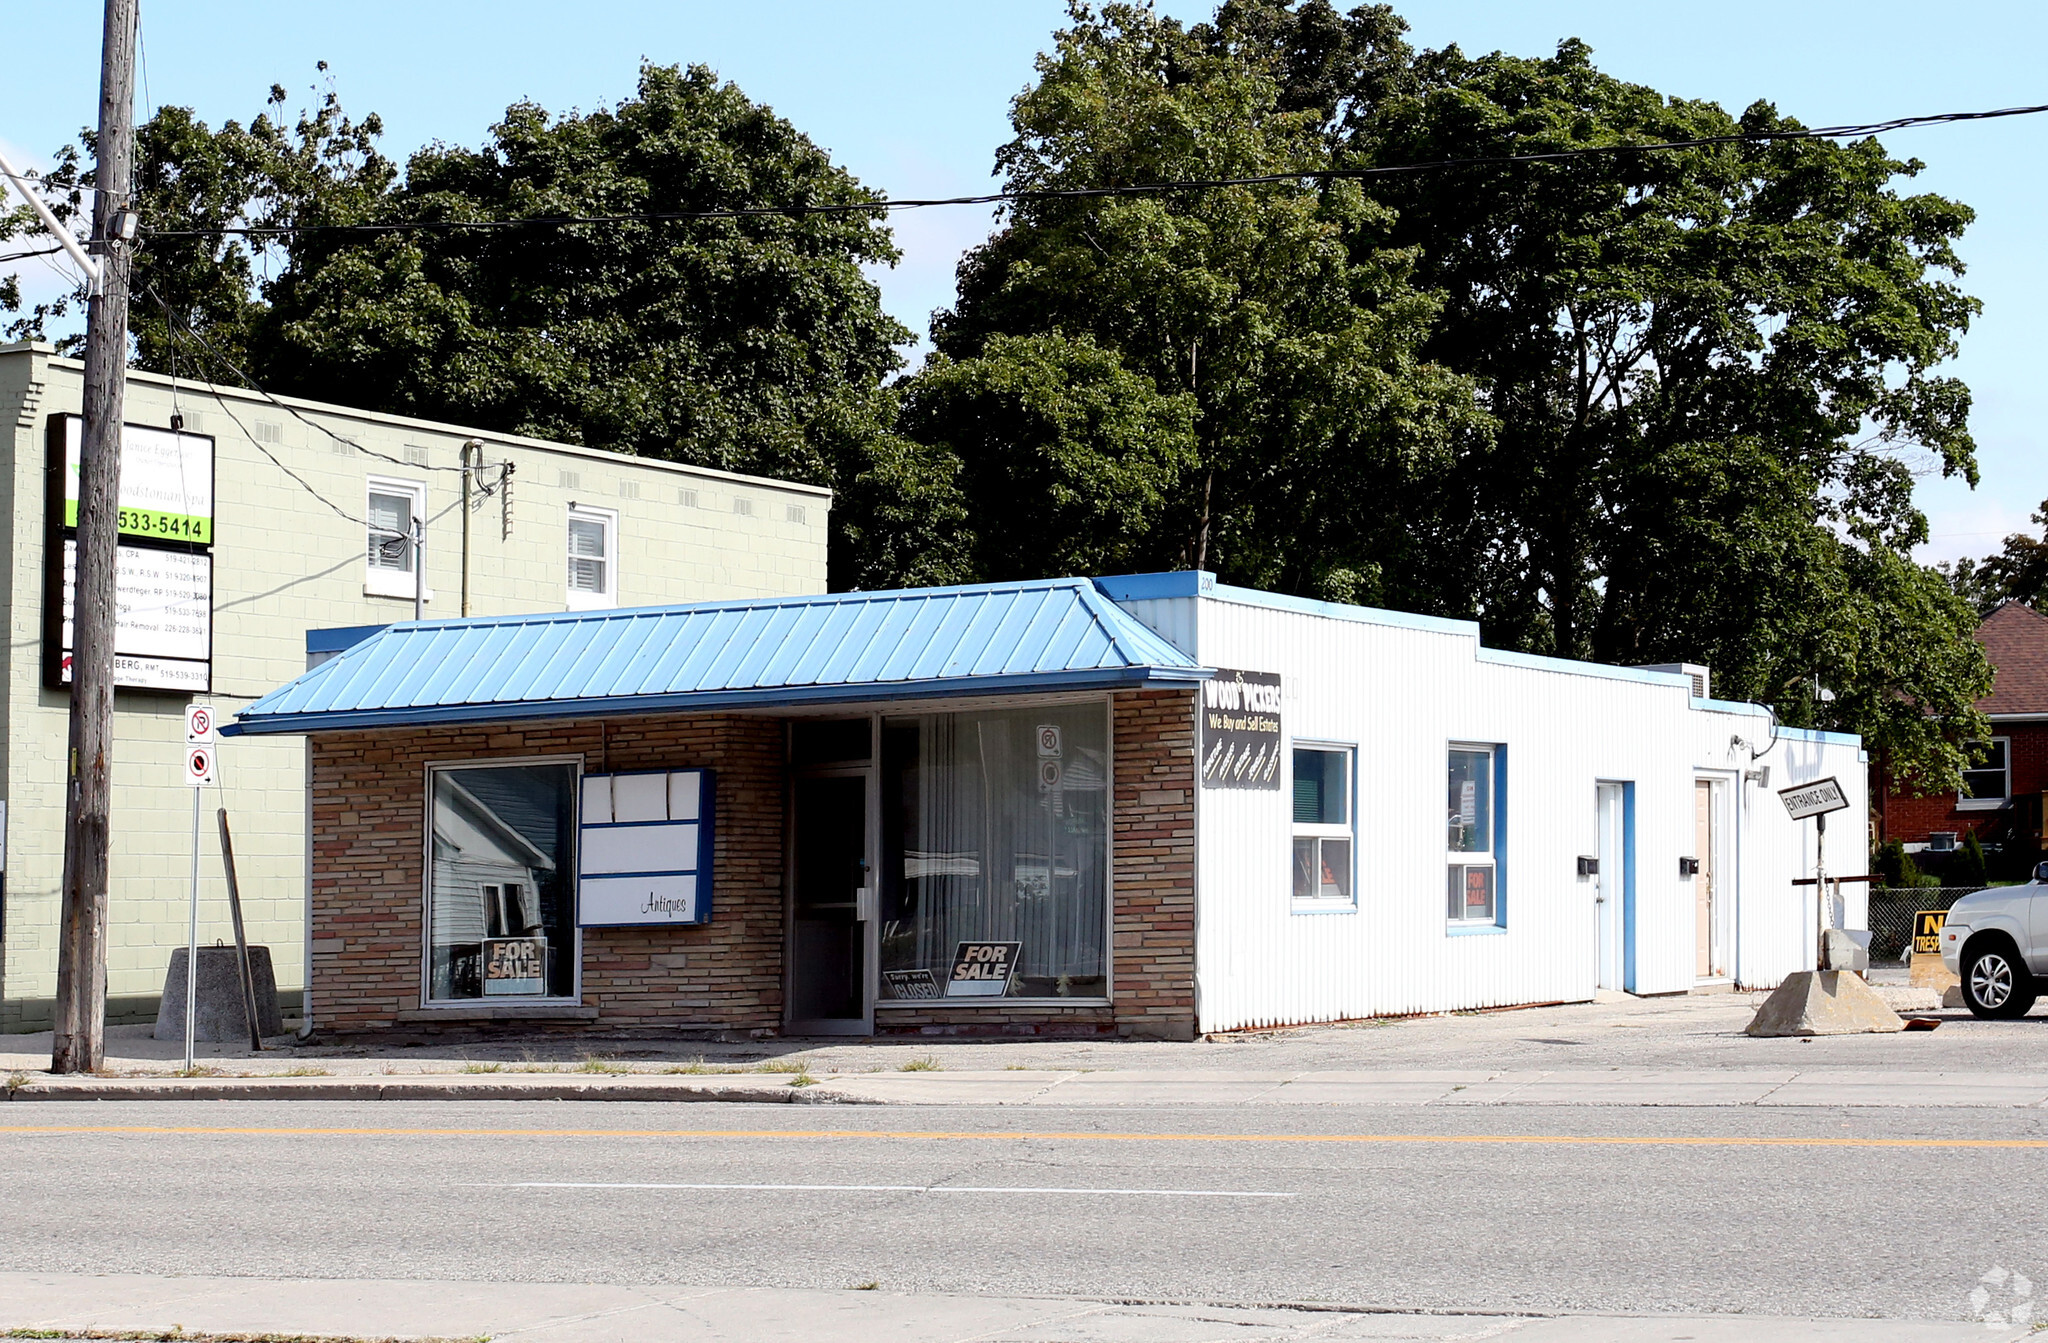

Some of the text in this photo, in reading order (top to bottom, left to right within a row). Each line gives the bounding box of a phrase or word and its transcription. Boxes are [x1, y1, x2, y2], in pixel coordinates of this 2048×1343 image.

[119, 482, 207, 509] oodstonian Spa
[118, 510, 202, 538] 533-5414
[130, 622, 160, 632] Removal
[115, 659, 143, 671] BERG,
[145, 663, 160, 672] RMT
[125, 675, 147, 685] Therapy
[1204, 680, 1281, 714] WOOD PICKERS
[1208, 713, 1279, 733] We Buy and Sell Estates
[1784, 785, 1839, 811] ENTRANCE ONLY
[1467, 872, 1485, 889] FOR
[641, 891, 687, 918] Antiques
[1923, 915, 1945, 935] N
[493, 941, 536, 961] FOR
[1915, 935, 1941, 952] TRESP
[963, 946, 1008, 962] FOR
[487, 960, 541, 979] SALE
[953, 963, 1008, 980] SALE
[894, 982, 939, 999] CLOSED
